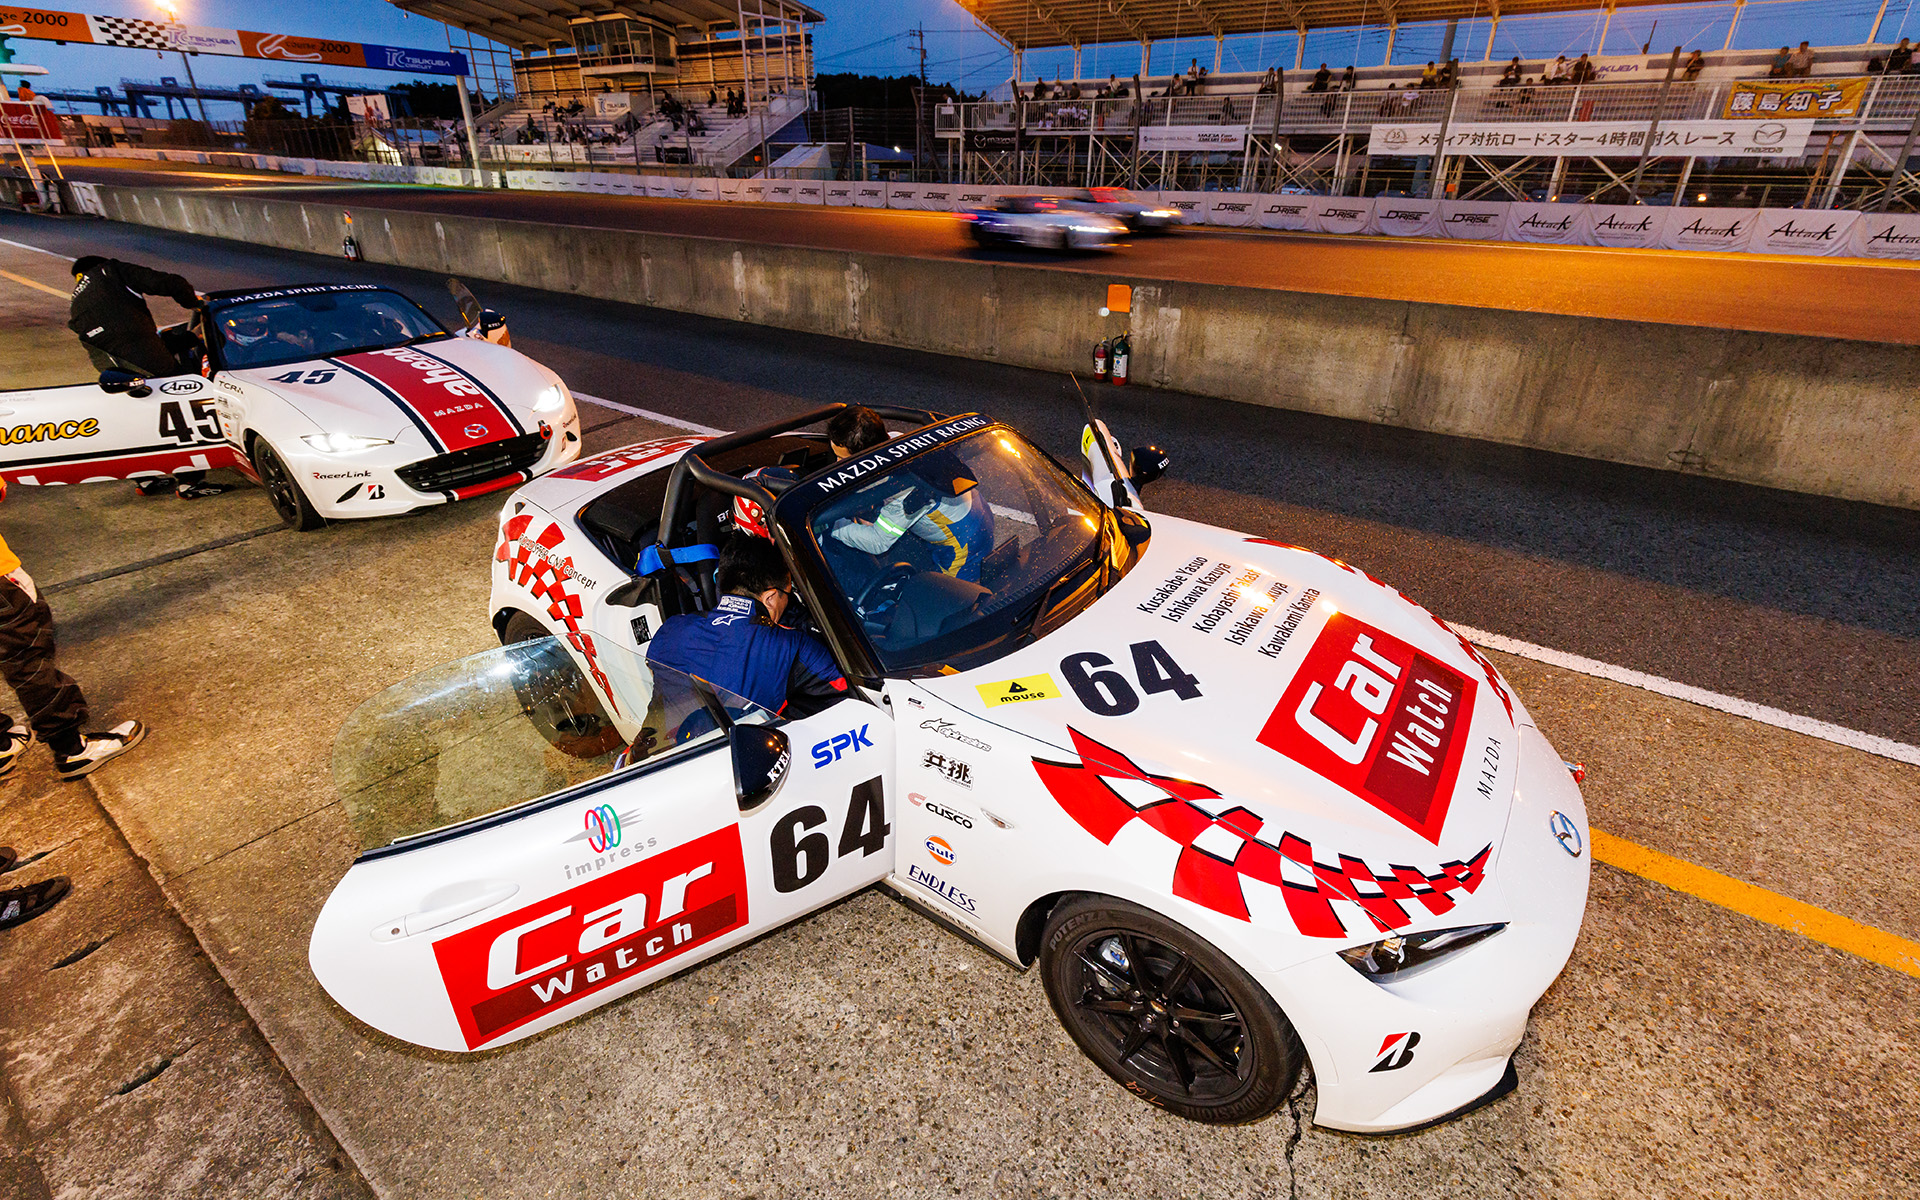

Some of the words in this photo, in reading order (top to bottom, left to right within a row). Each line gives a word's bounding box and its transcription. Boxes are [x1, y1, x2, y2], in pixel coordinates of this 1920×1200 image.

[22, 11, 68, 27] 2000
[188, 35, 236, 45] TSUKUBA
[319, 42, 350, 54] 2000
[405, 57, 451, 67] TSUKUBA
[1730, 90, 1843, 112] 藤島知子
[1518, 212, 1572, 231] Attack
[1594, 213, 1653, 232] Attack
[1678, 217, 1742, 238] Attack
[1767, 219, 1837, 241] Attack
[230, 291, 284, 304] MAZDA
[286, 285, 326, 295] SPIRIT
[164, 381, 199, 392] Arai
[268, 368, 339, 385] 45
[159, 397, 225, 443] 45
[433, 402, 483, 417] MAZDA
[816, 454, 891, 493] MAZDA
[888, 432, 938, 458] SPIRIT
[935, 416, 987, 439] RACING
[312, 470, 372, 480] RacerLink
[547, 551, 566, 571] CNF
[563, 563, 598, 590] concept
[1136, 574, 1188, 614] Kusakabe
[1176, 556, 1208, 580] Yasuo
[1161, 585, 1207, 623] Ishikawa
[1195, 562, 1232, 588] Kazuya
[1191, 587, 1241, 634] Kobayashi
[1224, 604, 1269, 646] Ishikawa
[1257, 609, 1300, 659] Kawakami
[1290, 587, 1321, 614] Kanata
[1000, 690, 1046, 703] mouse
[1060, 640, 1204, 717] 64
[1294, 632, 1403, 766] Car
[811, 723, 875, 770] SPK
[1386, 678, 1453, 777] Watch
[766, 749, 792, 784] KTEL
[1476, 736, 1502, 800] MAZDA
[770, 774, 891, 895] 64
[925, 802, 973, 830] CUSCO
[563, 835, 657, 880] impress
[925, 841, 955, 861] Gulf
[908, 864, 977, 911] ENDLESS
[487, 861, 713, 990] Car
[1050, 910, 1110, 952] POTENZA
[531, 921, 693, 1003] Watch
